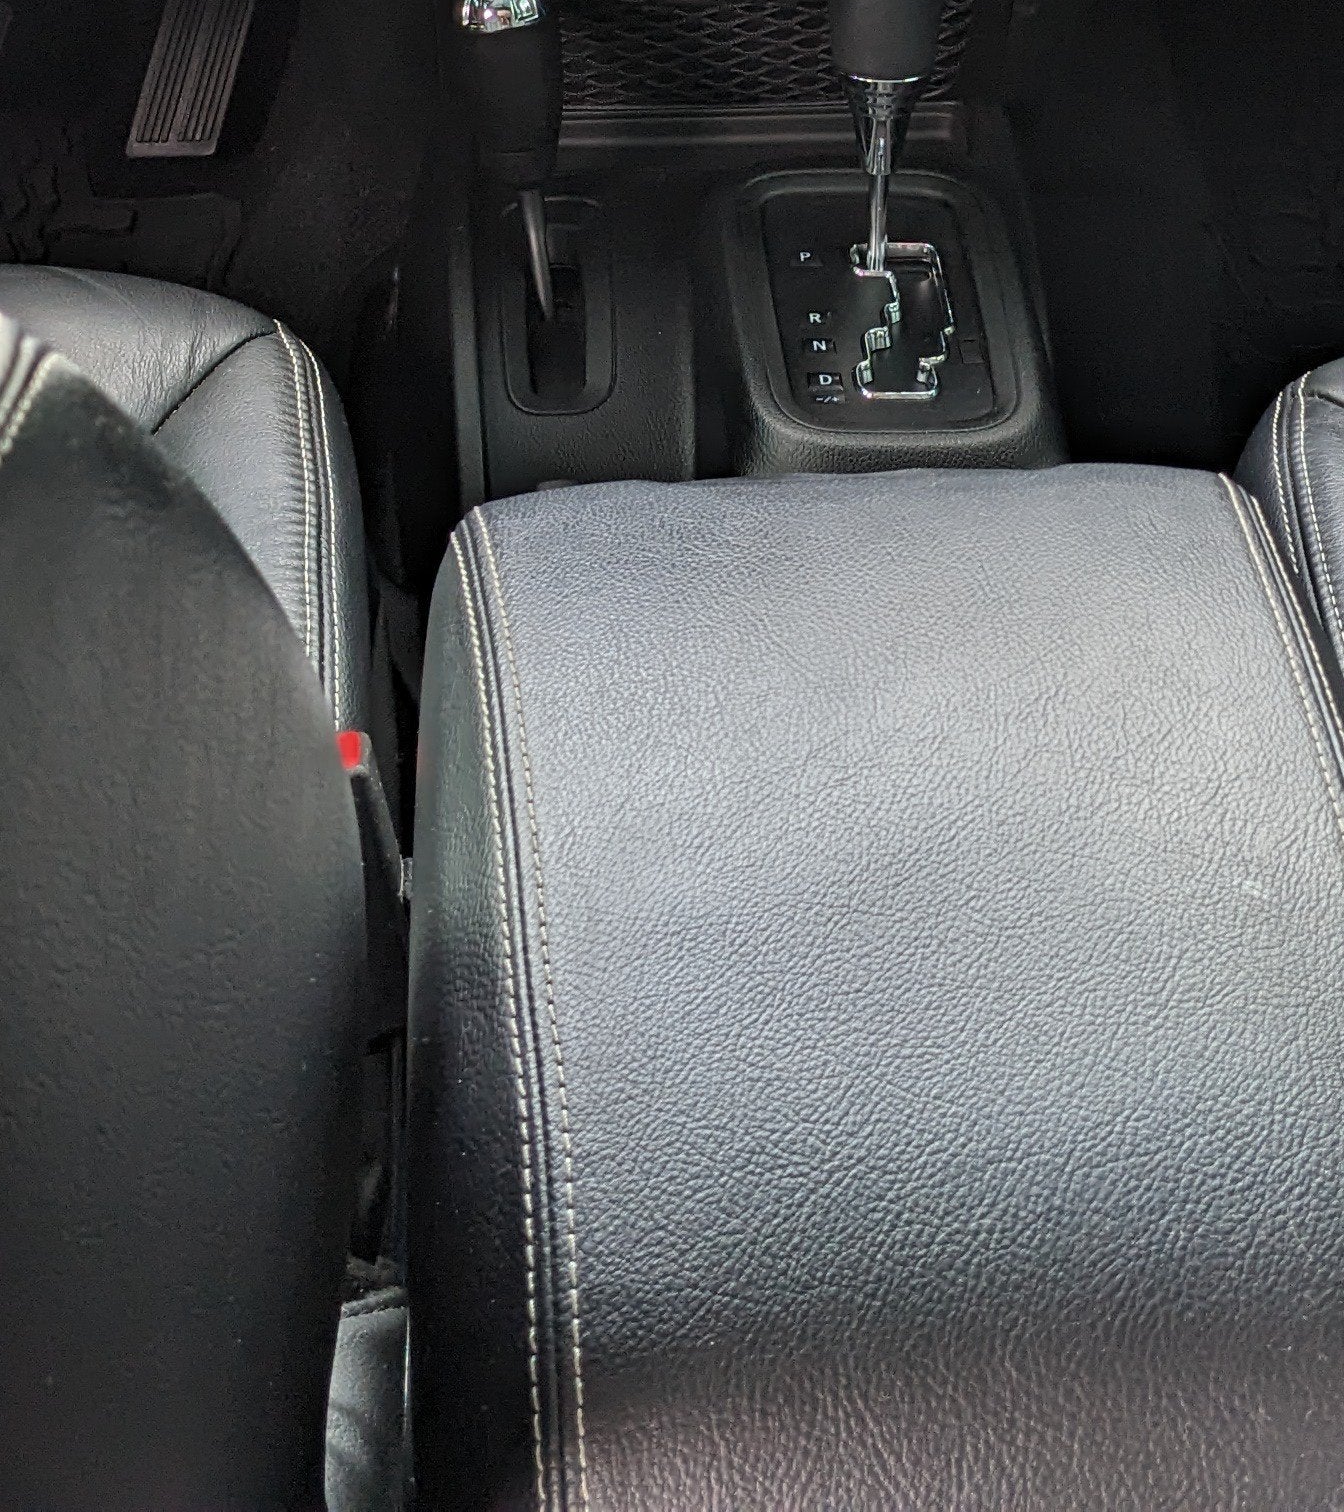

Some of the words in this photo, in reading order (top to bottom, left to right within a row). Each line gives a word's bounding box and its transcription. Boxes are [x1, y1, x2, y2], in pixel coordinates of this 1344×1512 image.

[800, 251, 811, 262] P
[809, 313, 821, 324] R
[812, 340, 827, 351] N
[819, 374, 832, 386] D
